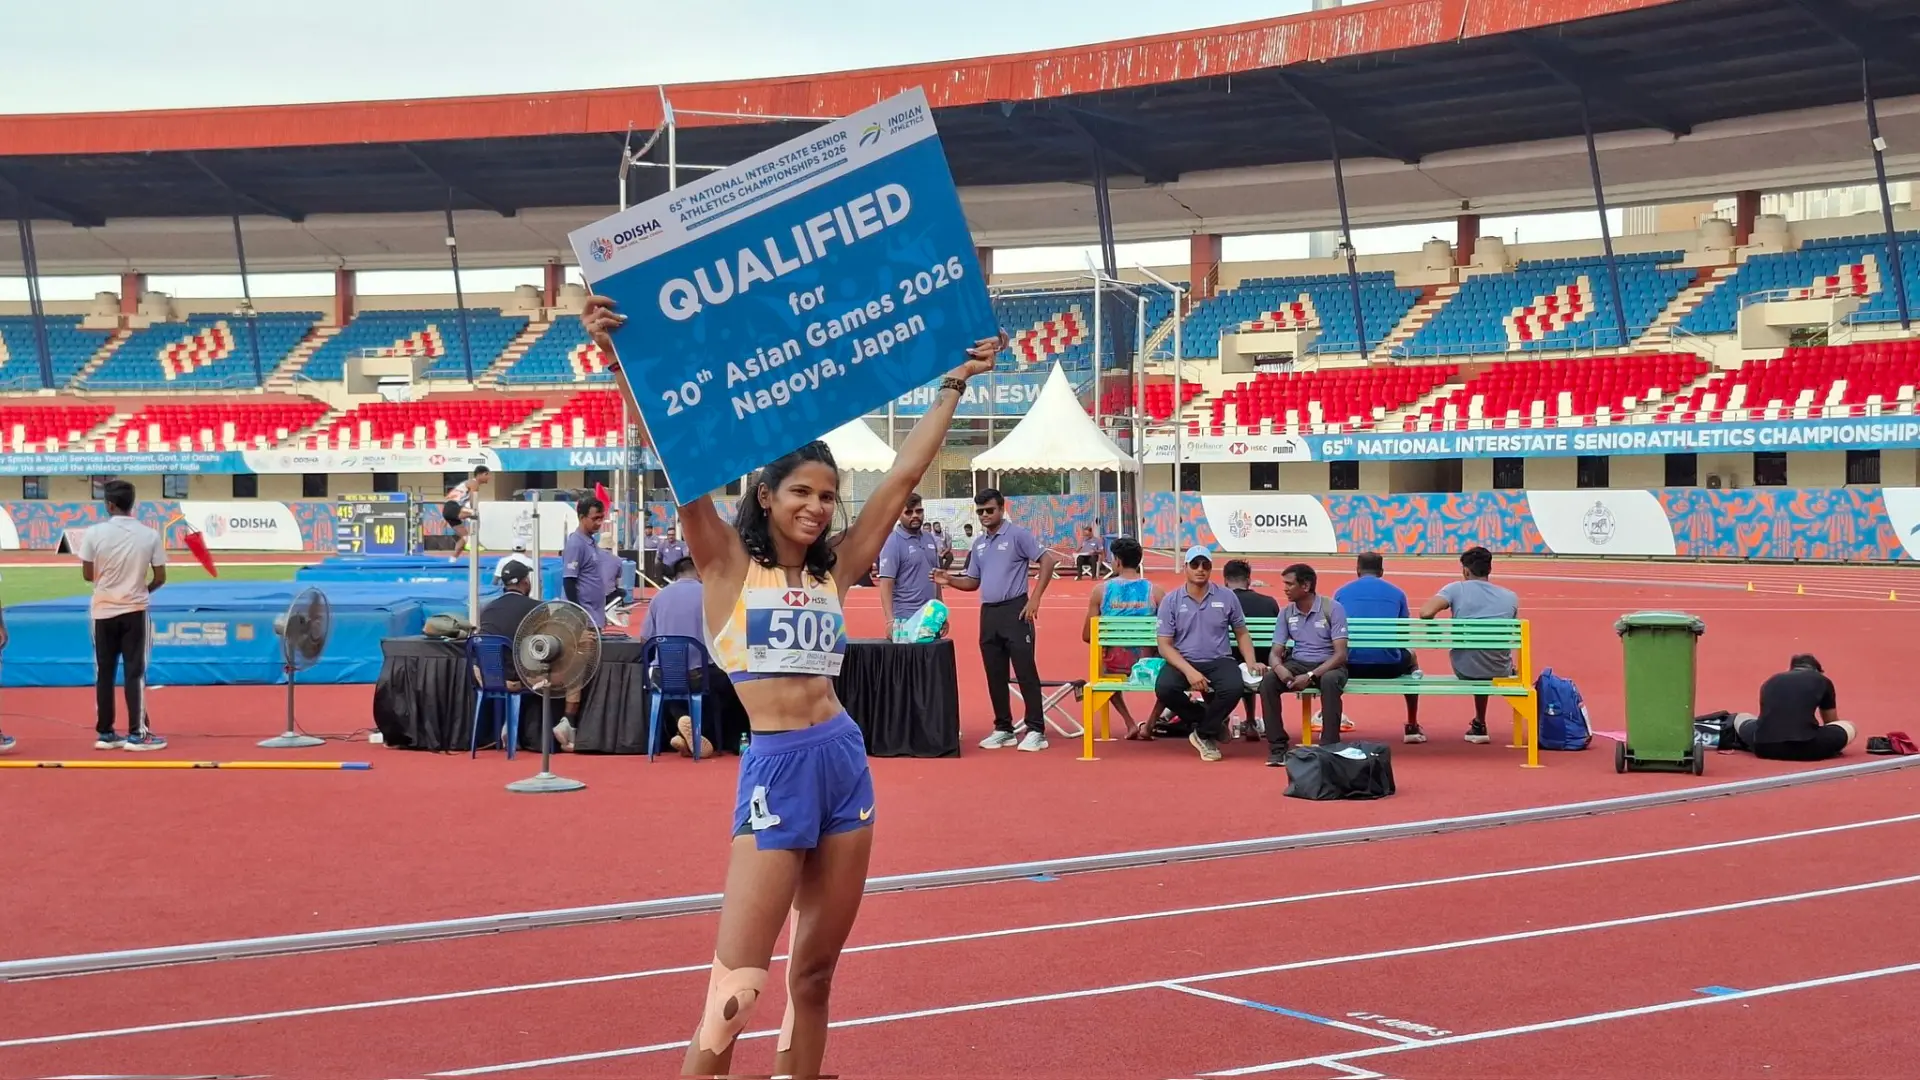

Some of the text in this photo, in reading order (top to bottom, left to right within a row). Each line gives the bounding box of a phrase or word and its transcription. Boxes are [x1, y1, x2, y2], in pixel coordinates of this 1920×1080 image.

[887, 105, 922, 127] INDIAN
[890, 115, 925, 135] ATHLETICS
[689, 176, 744, 205] NATIONAL
[745, 147, 809, 180] INTER-STATE
[811, 130, 848, 153] SENIOR
[680, 193, 736, 223] ATHLETICS
[737, 153, 820, 198] CHAMPIONSHIPS
[822, 144, 847, 161] 2026
[614, 218, 662, 245] ODISHA
[658, 183, 911, 321] QUALIFIED
[789, 283, 826, 316] for
[662, 256, 964, 417] 20th Asian Games 2026
[731, 314, 926, 421] Nagoya, Japan
[1322, 437, 1353, 455] 65th
[1357, 438, 1451, 455] NATIONAL
[1456, 434, 1568, 453] INTERSTATE
[229, 517, 278, 529] ODISHA
[352, 524, 360, 538] 1
[1254, 514, 1309, 528] ODISHA
[352, 540, 361, 553] 7
[767, 609, 836, 653] 508
